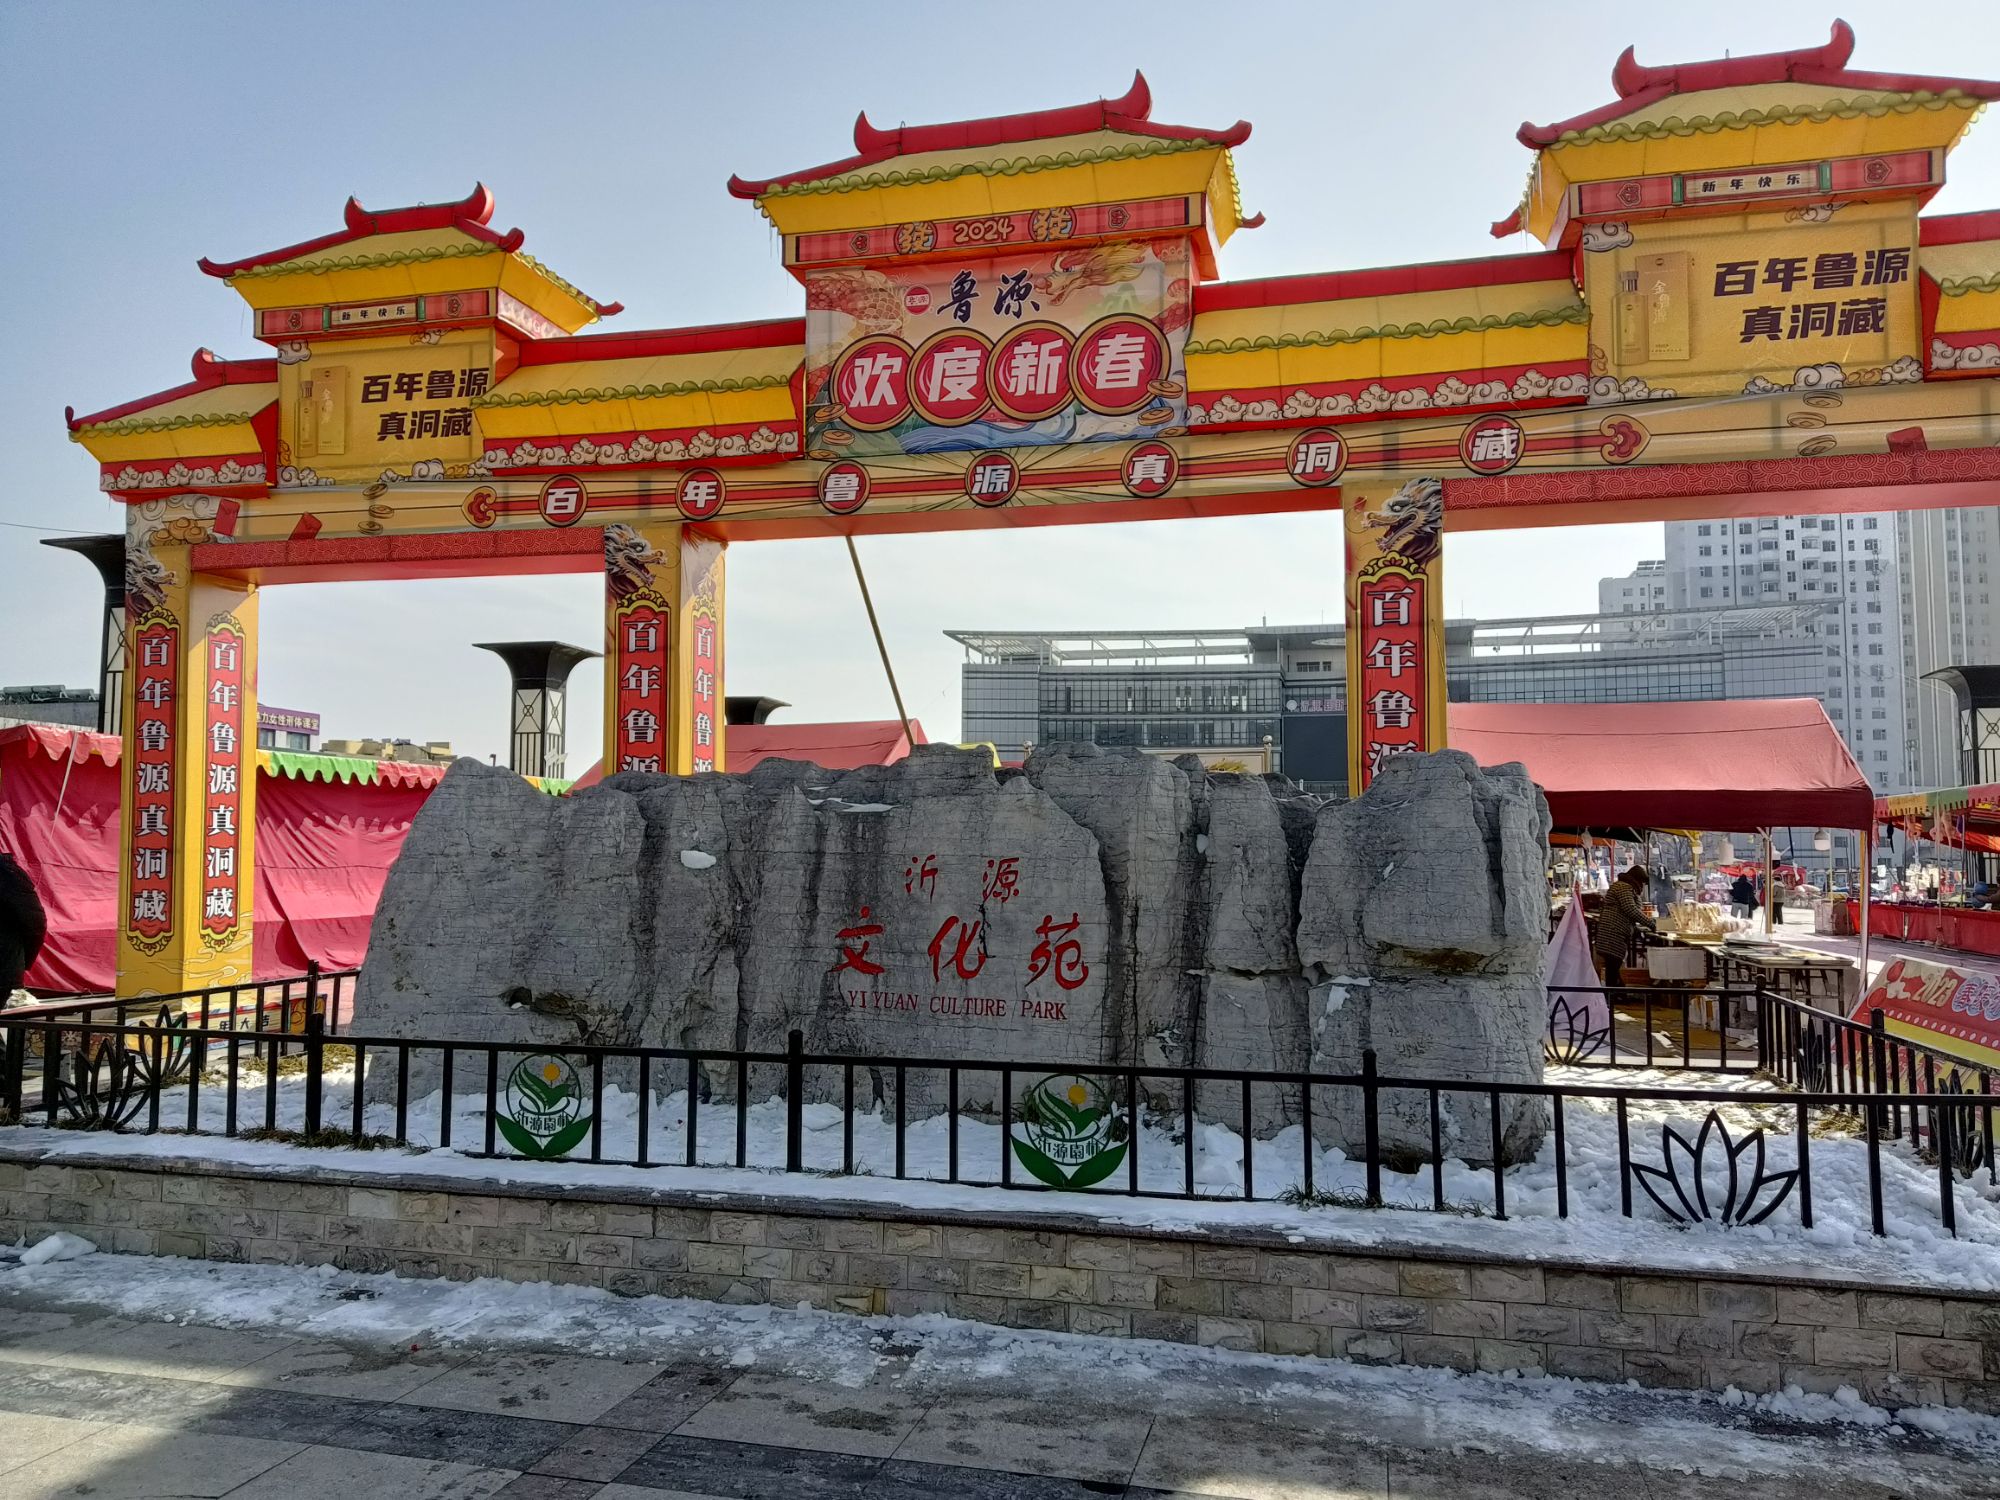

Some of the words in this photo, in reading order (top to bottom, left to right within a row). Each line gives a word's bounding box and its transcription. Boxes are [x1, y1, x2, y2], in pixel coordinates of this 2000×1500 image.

[1702, 174, 1800, 192] 新年快乐
[953, 217, 1014, 243] 2024
[1714, 247, 1910, 296] 百年鲁源
[341, 305, 405, 321] 新年快乐
[1740, 298, 1886, 343] 真洞藏
[361, 367, 489, 403] 百年鲁源
[849, 333, 1146, 407] 欢度新春
[377, 408, 473, 441] 真洞藏
[133, 634, 172, 922] 百年鲁源真洞藏
[205, 640, 239, 919] 百年鲁源真洞藏
[905, 854, 1020, 903] 沂源
[828, 905, 1089, 990] 文化苑
[848, 991, 867, 1008] YI
[872, 992, 919, 1012] YUAN
[929, 996, 1007, 1017] CULTURE
[1021, 1000, 1067, 1020] PARK
